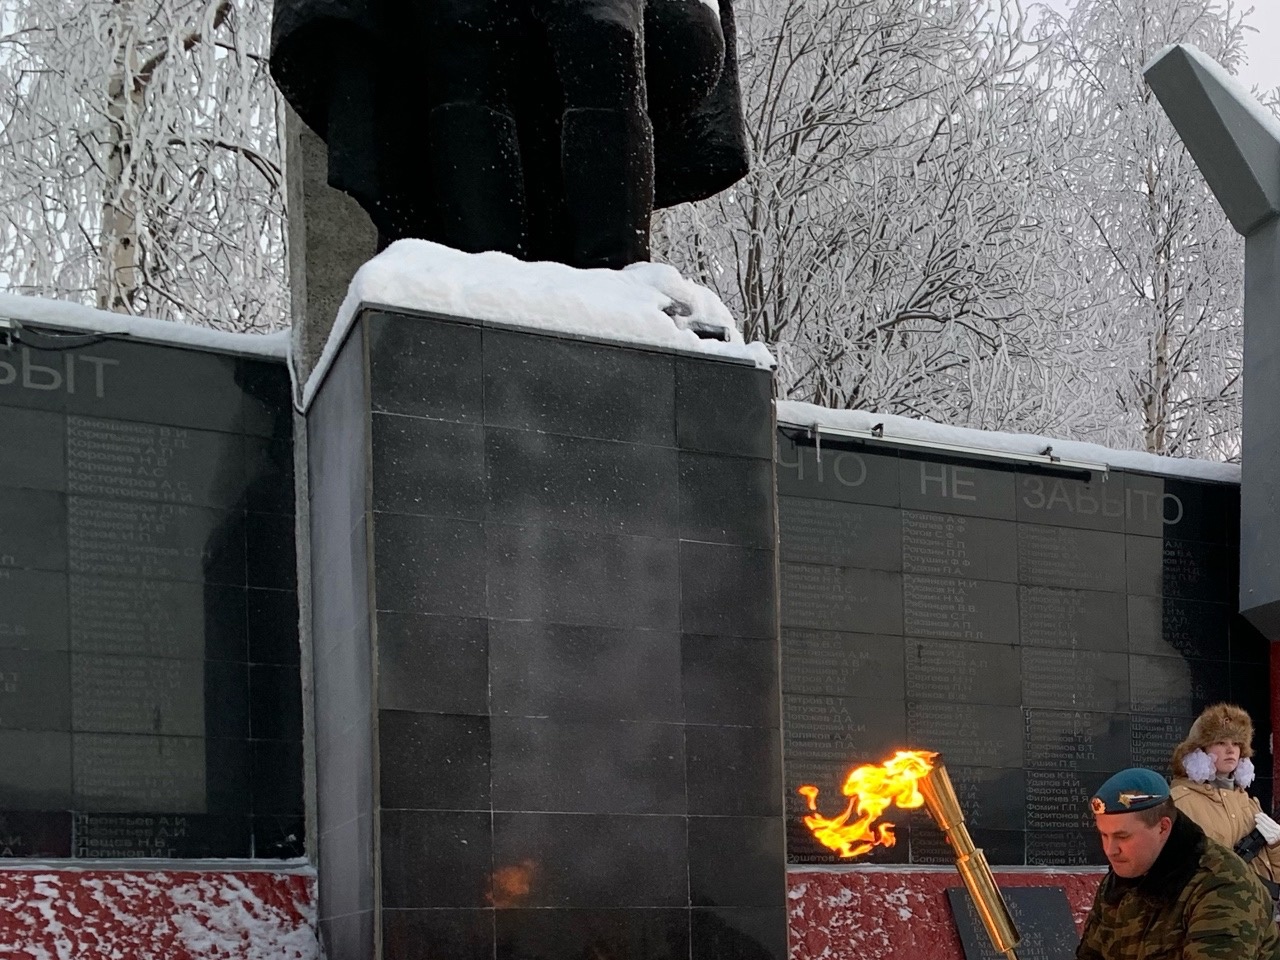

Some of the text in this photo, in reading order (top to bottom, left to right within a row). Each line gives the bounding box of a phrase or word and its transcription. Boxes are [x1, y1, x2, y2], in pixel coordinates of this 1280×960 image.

[778, 446, 1184, 525] ЧТО НЕ ЗАБЫТО
